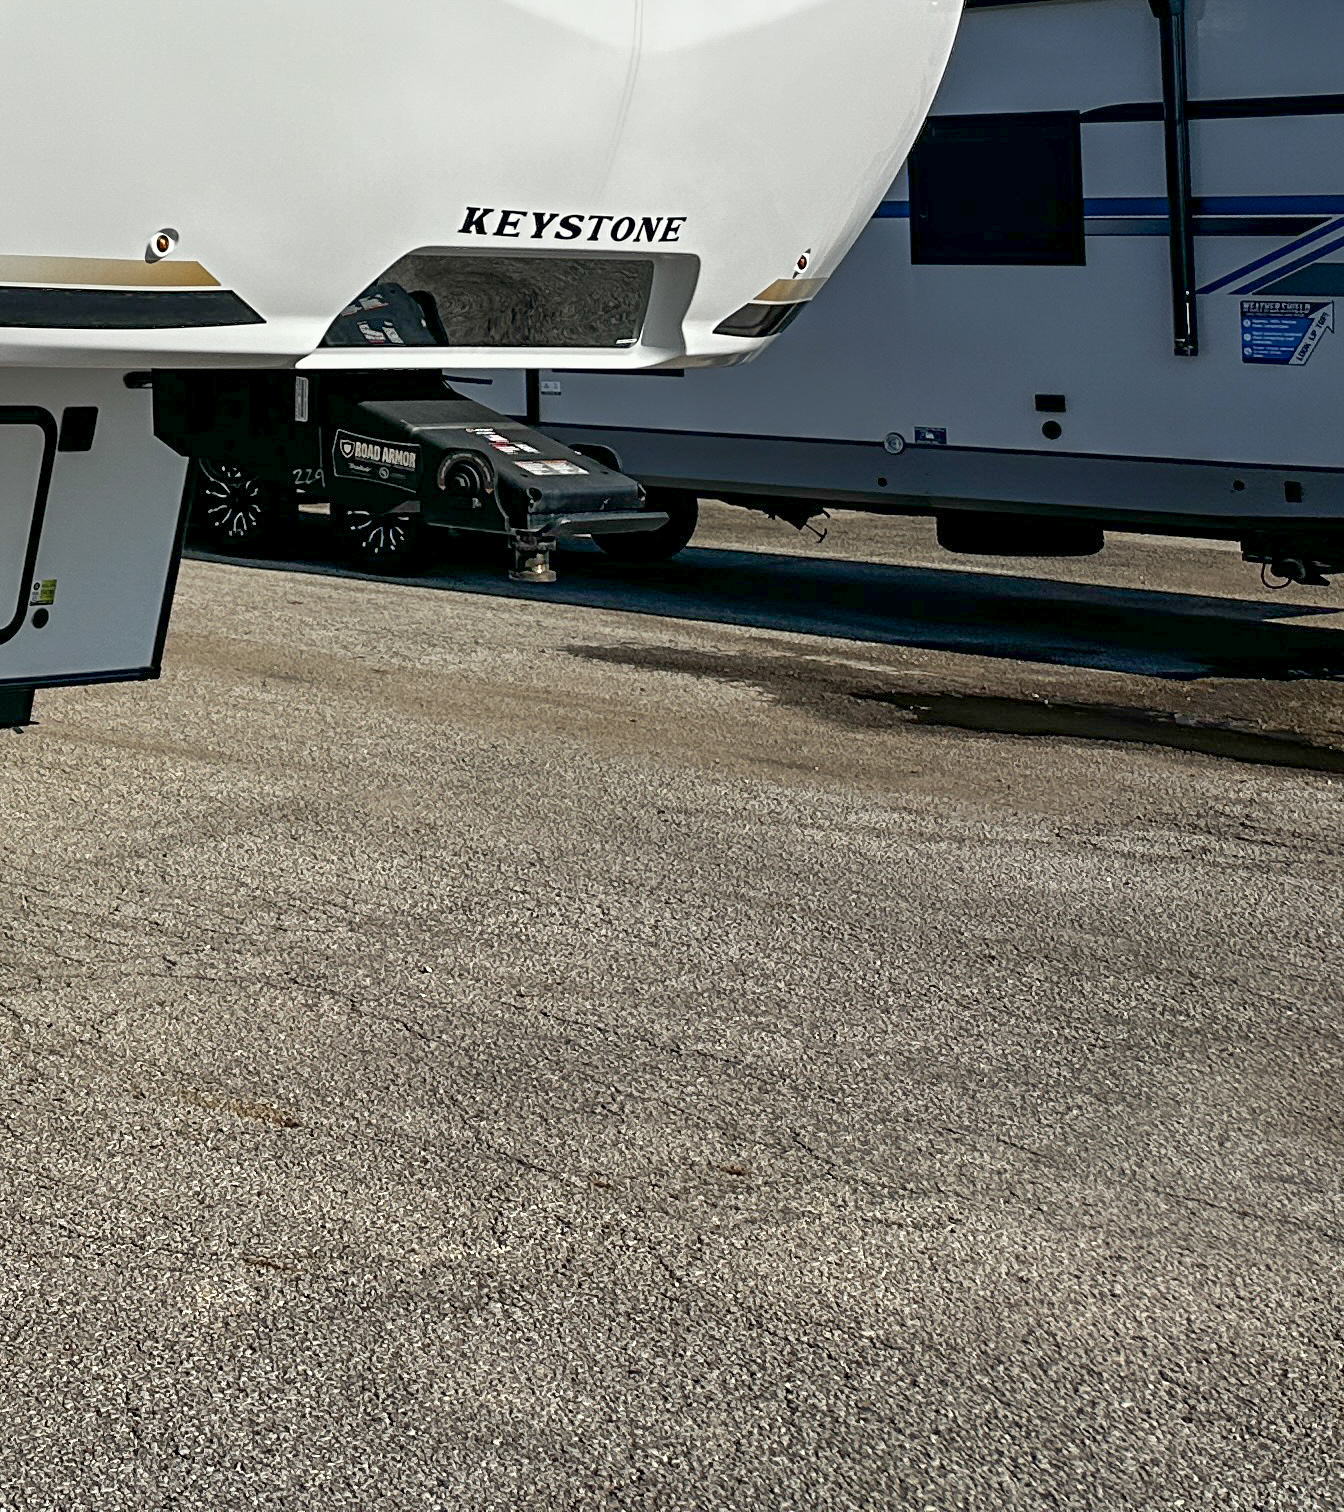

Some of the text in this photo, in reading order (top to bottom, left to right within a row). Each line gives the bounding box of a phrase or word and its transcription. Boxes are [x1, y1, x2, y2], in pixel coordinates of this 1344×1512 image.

[457, 206, 688, 243] KEYSTONE
[354, 441, 381, 461] ROAD
[382, 446, 417, 468] ARMOR
